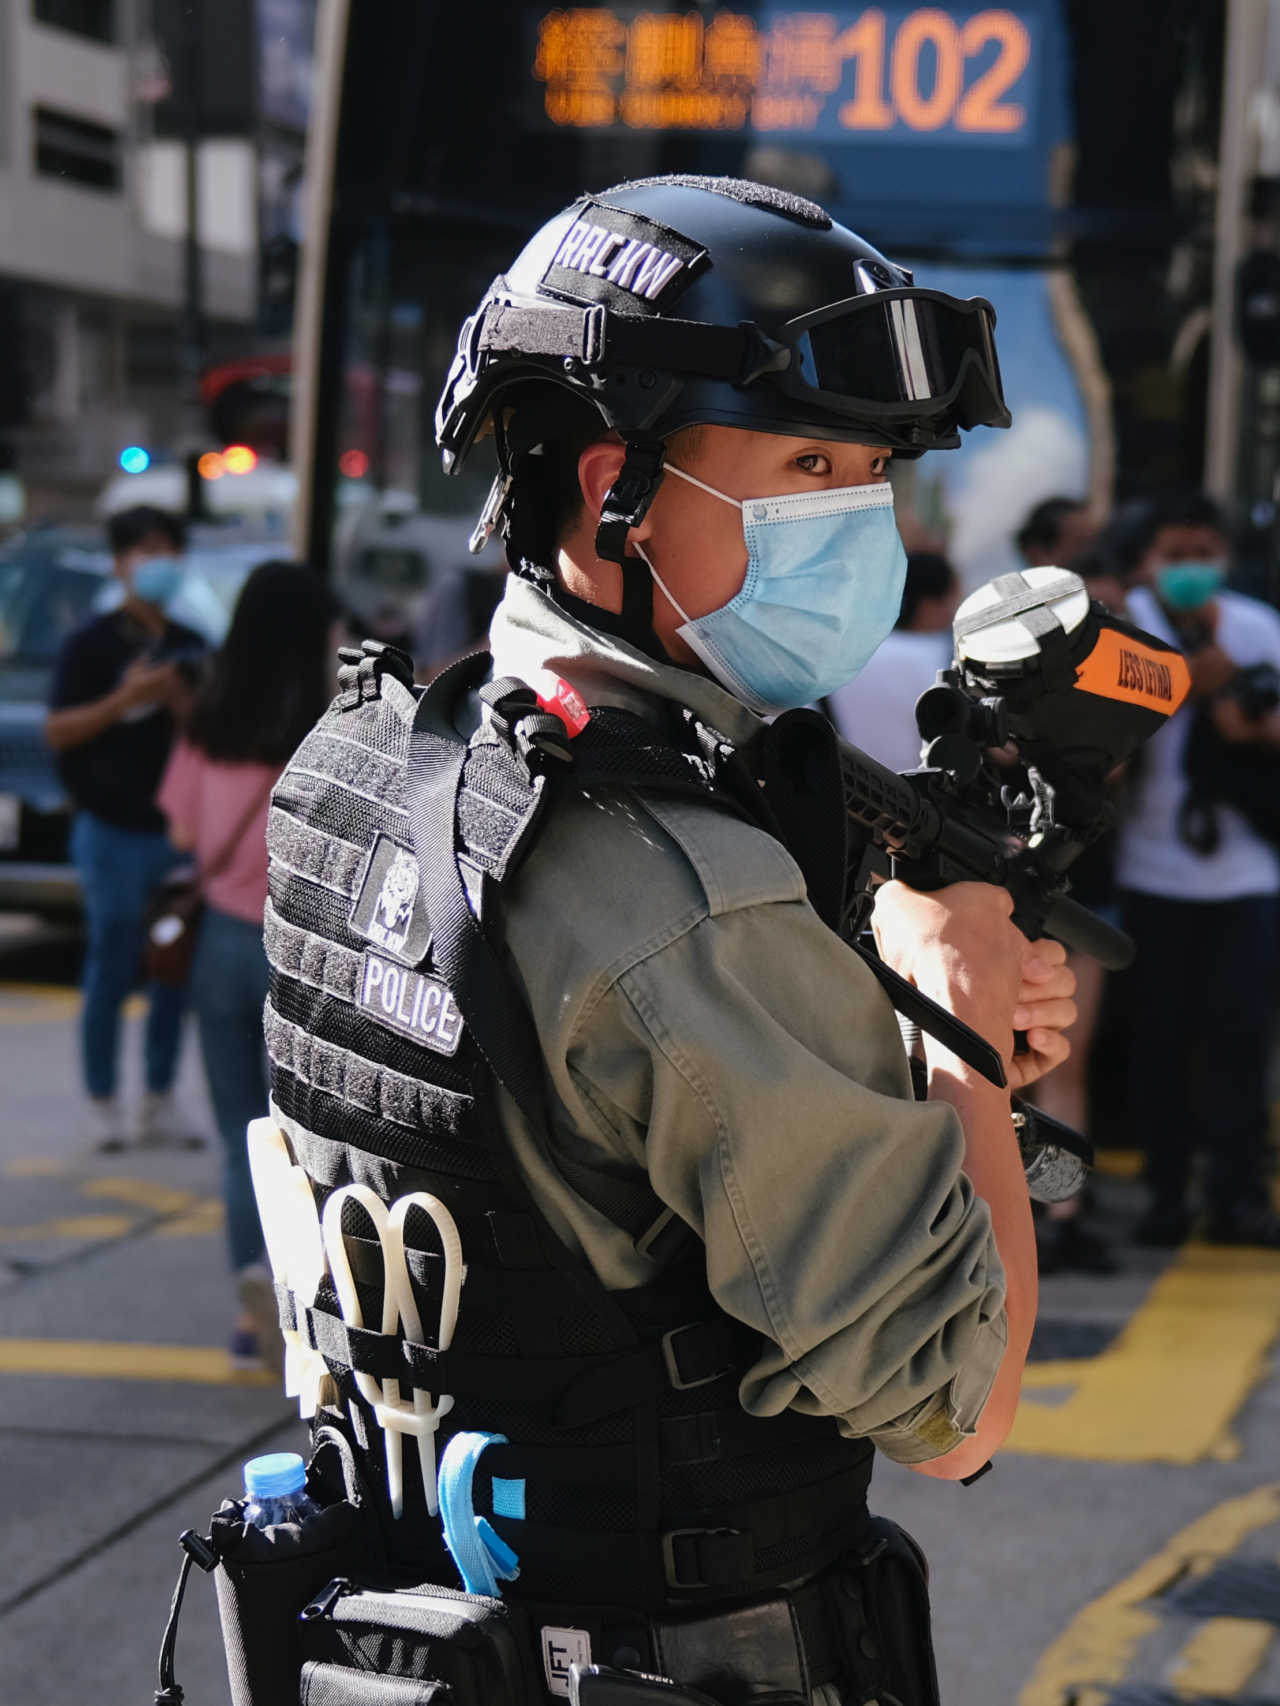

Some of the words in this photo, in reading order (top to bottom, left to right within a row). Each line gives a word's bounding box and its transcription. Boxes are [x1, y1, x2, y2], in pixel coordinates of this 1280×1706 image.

[838, 7, 1031, 132] 102
[555, 220, 684, 300] RRCKW
[1117, 648, 1144, 693] LESS
[1141, 657, 1172, 701] LETHAL
[363, 957, 457, 1042] POLICE
